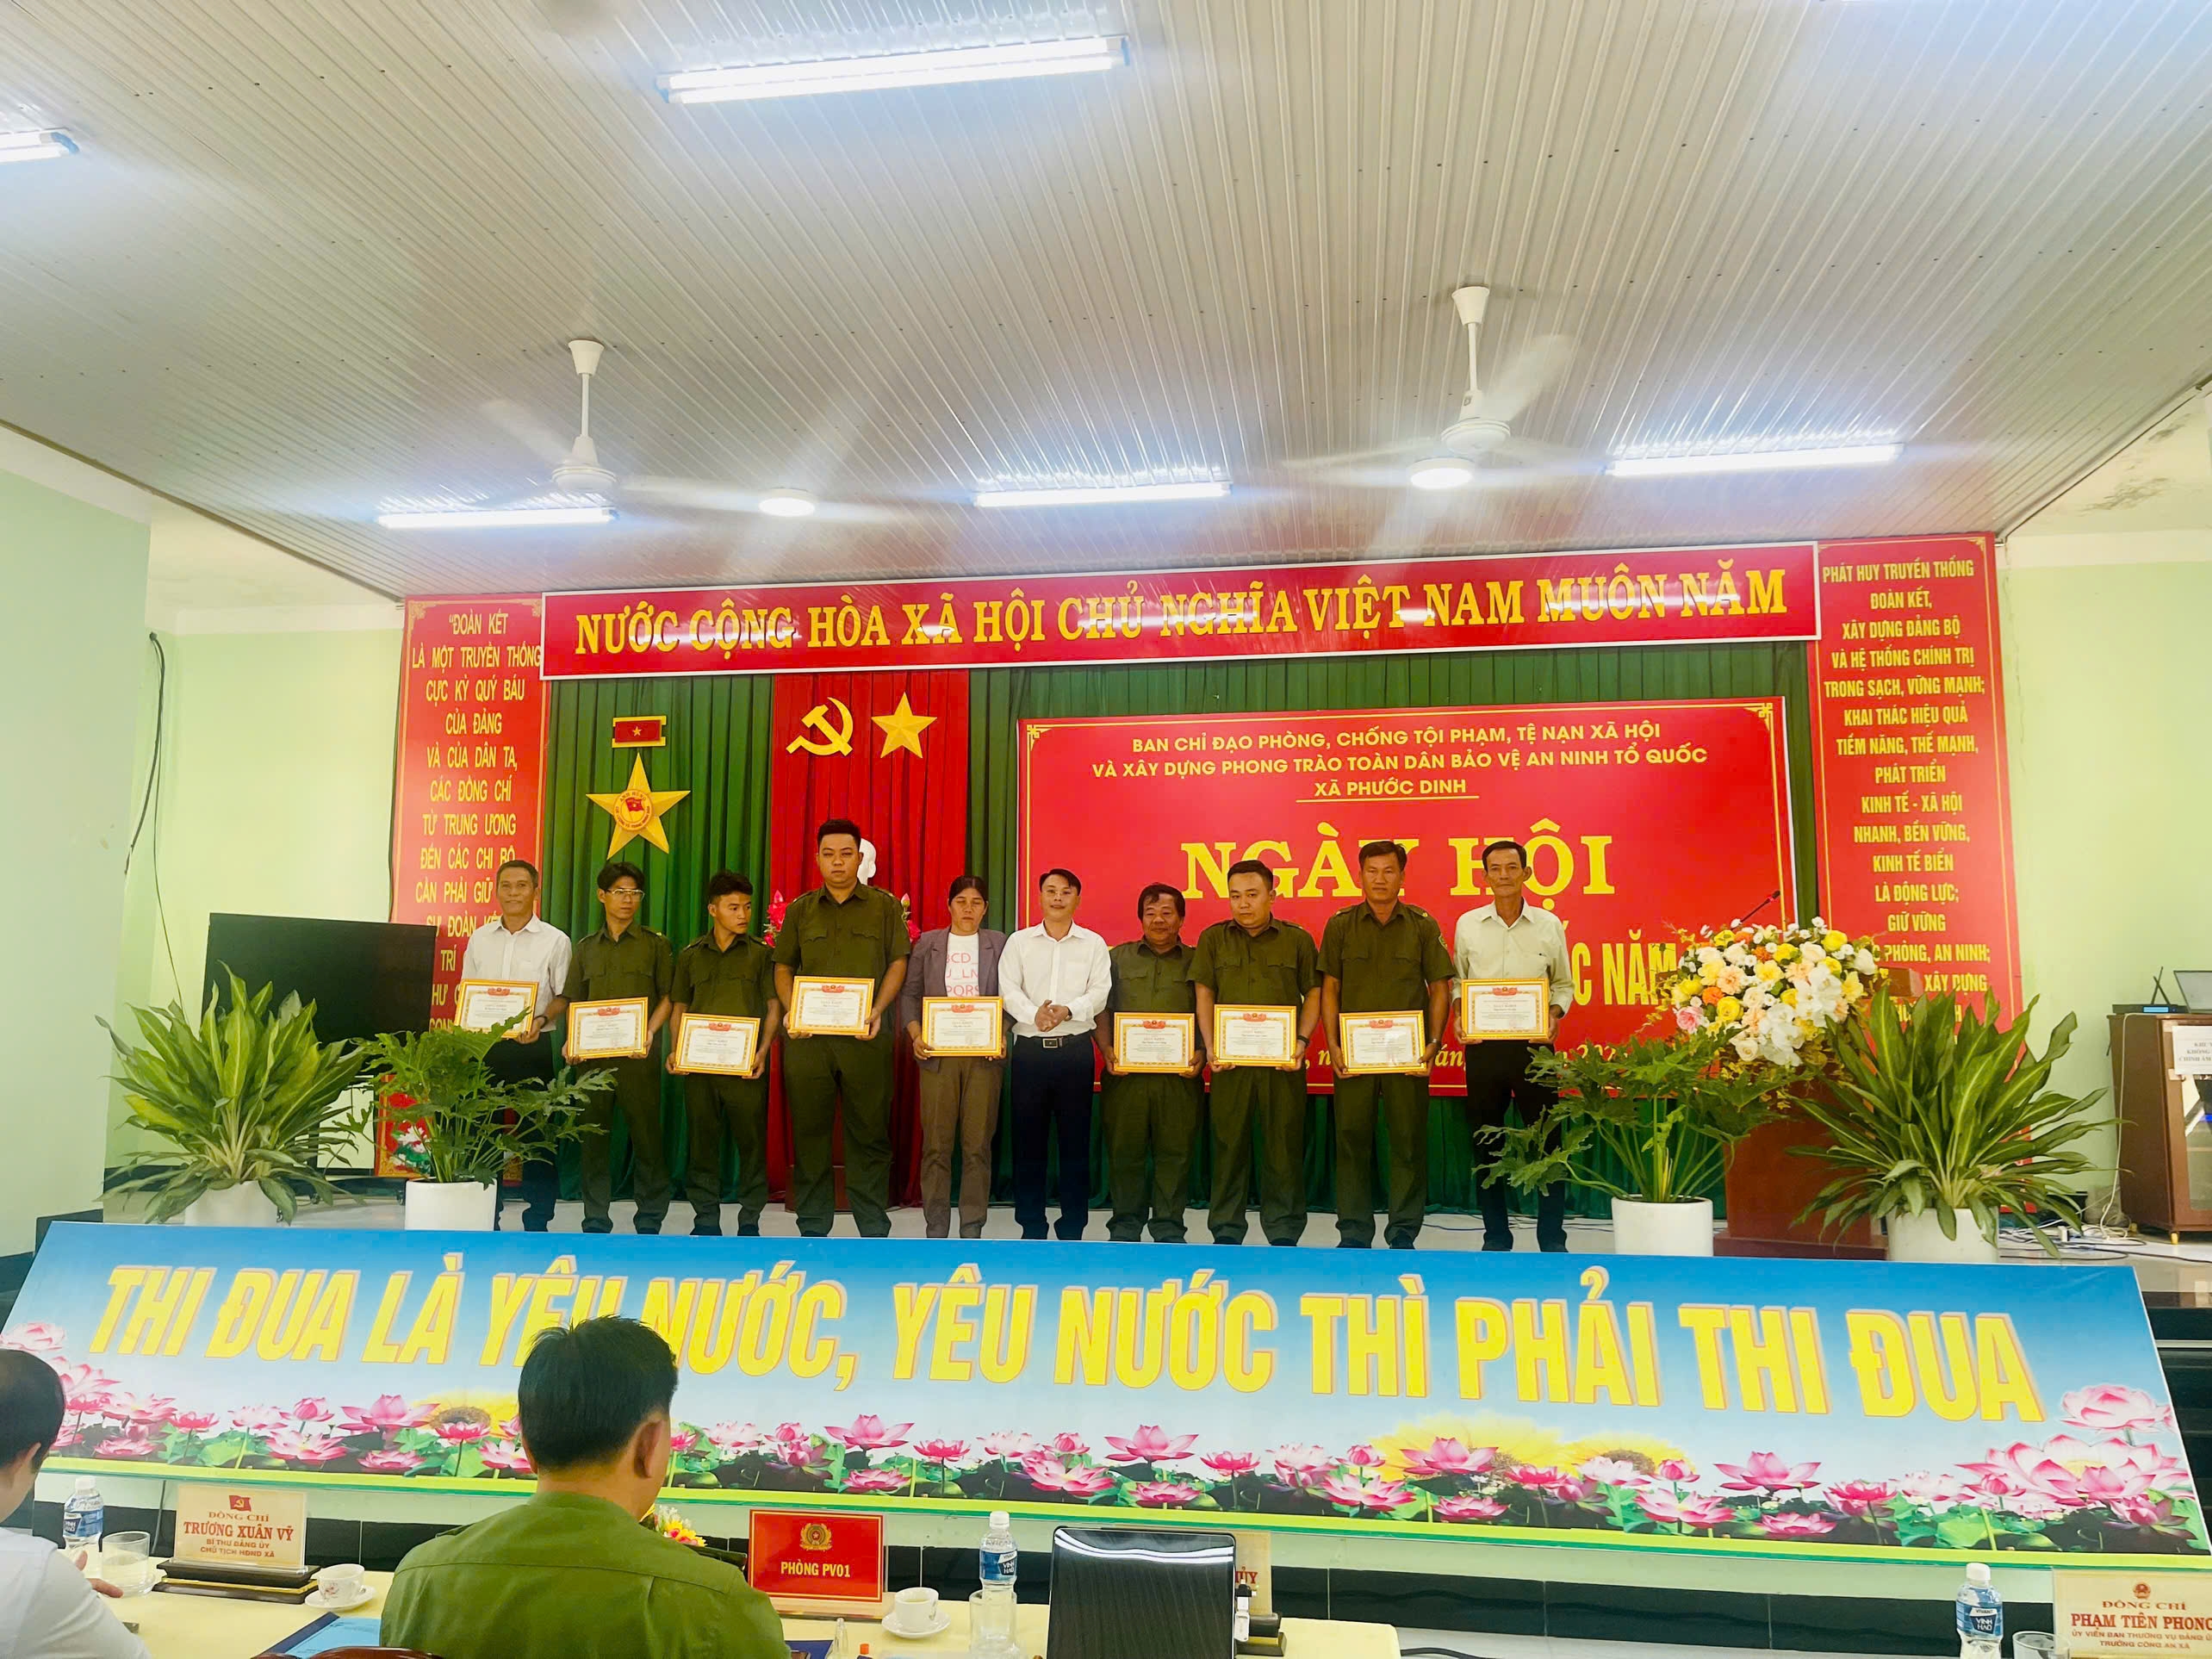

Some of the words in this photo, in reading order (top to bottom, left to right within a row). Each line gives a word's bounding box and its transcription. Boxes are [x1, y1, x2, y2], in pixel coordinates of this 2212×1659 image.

[1823, 562, 1854, 583] PHÁT
[1856, 564, 1880, 581] HUY
[1933, 556, 1974, 578] THỐNG
[575, 600, 680, 655] NƯỚC
[690, 598, 797, 660] CỘNG
[807, 594, 891, 648] HÒA
[902, 592, 963, 646] XÃ
[973, 587, 1046, 652] HỘI
[1058, 580, 1144, 641] CHỦ
[1160, 581, 1297, 637] NGHĨA
[1304, 574, 1411, 640] VIỆT
[1423, 581, 1525, 627] NAM
[1537, 562, 1668, 623] MUÔN
[1679, 558, 1787, 617] NĂM
[1870, 588, 1904, 610] ĐOÀN
[1907, 586, 1932, 609] KẾT,
[488, 608, 508, 635] KẾT
[1842, 619, 1866, 640] XÂY
[1869, 619, 1904, 642] DỰNG
[1906, 613, 1940, 637] ĐẢNG
[1943, 614, 1960, 639] BỘ
[412, 642, 425, 668] LÀ
[432, 644, 454, 674] MỘT
[461, 641, 500, 668] TRUYỀN
[506, 641, 542, 668] THỐNG
[1831, 648, 1848, 669] VÀ
[1850, 647, 1867, 672] HỆ
[1869, 643, 1910, 668] THỐNG
[1913, 644, 1952, 666] CHÍNH
[1954, 647, 1975, 668] TRỊ
[426, 680, 449, 707] CỰC
[475, 674, 497, 702] QUÝ
[503, 674, 525, 701] BÁU
[1824, 680, 1864, 698] TRONG
[1867, 679, 1904, 699] SẠCH,
[1907, 674, 1941, 695] VỮNG
[1943, 675, 1985, 697] MẠNH;
[445, 707, 467, 735] CỦA
[473, 707, 502, 735] ĐẢNG
[1844, 709, 1873, 726] KHAI
[1876, 705, 1908, 725] THÁC
[1911, 704, 1939, 728] HIỆU
[1942, 700, 1968, 724] QUẢ
[1133, 738, 1169, 753] BAN
[1174, 731, 1207, 751] CHỈ
[1212, 735, 1253, 754] ĐẠO
[1258, 731, 1331, 750] PHÒNG,
[1336, 726, 1408, 747] CHỐNG
[1414, 725, 1444, 747] TỘI
[1450, 727, 1511, 747] PHẠM,
[1517, 721, 1537, 745] TỆ
[1543, 725, 1582, 744] NẠN
[1591, 721, 1619, 740] XÃ
[1625, 719, 1661, 743] HỘI
[1869, 734, 1908, 755] NĂNG,
[1911, 730, 1934, 754] THẾ
[1937, 735, 1979, 756] MẠNH,
[426, 742, 440, 768] VÀ
[447, 742, 469, 768] CỦA
[475, 742, 496, 768] DÂN
[503, 746, 518, 772] TA,
[1092, 760, 1117, 778] VÀ
[1122, 759, 1159, 777] XÂY
[1164, 760, 1216, 780] DỰNG
[1221, 758, 1289, 775] PHONG
[1293, 756, 1342, 773] TRÀO
[1347, 753, 1399, 771] TOÀN
[1404, 750, 1441, 770] DÂN
[1451, 748, 1492, 768] BẢO
[1497, 748, 1520, 771] VỆ
[1525, 751, 1554, 767] AN
[1560, 749, 1609, 766] NINH
[1613, 742, 1640, 764] TỔ
[1645, 743, 1707, 765] QUỐC
[1874, 762, 1907, 784] PHÁT
[1910, 759, 1946, 783] TRIỂN
[430, 775, 451, 802] CÁC
[457, 775, 488, 802] ĐỒNG
[494, 774, 513, 802] CHÍ
[1314, 779, 1340, 797] XÃ
[1346, 775, 1414, 795] PHƯỚC
[1420, 780, 1466, 794] DINH
[1861, 796, 1892, 813] KINH
[1894, 790, 1910, 813] TẾ
[1921, 792, 1938, 812] XÃ
[1942, 791, 1963, 816] HỘI
[422, 809, 438, 836] TỪ
[444, 813, 478, 836] TRUNG
[484, 813, 517, 836] ƯƠNG
[1854, 825, 1901, 844] NHANH,
[1932, 821, 1970, 843] VỮNG,
[420, 842, 442, 869] ĐẾN
[448, 842, 469, 869] CÁC
[476, 847, 494, 869] CHI
[1448, 817, 1615, 911] HỘI
[1873, 854, 1903, 873] KINH
[1906, 848, 1921, 872] TẾ
[1924, 847, 1954, 872] BIỂN
[415, 876, 438, 904] CẦN
[444, 876, 468, 904] PHẢI
[474, 877, 494, 904] GIỮ
[1874, 881, 1891, 903] LÀ
[1893, 881, 1929, 905] ĐỘNG
[1931, 883, 1959, 904] LỰC;
[448, 910, 476, 938] ĐOÀN
[1887, 911, 1910, 931] GIỮ
[1912, 910, 1946, 931] VỮNG
[441, 945, 457, 972] TRÍ
[1884, 940, 1931, 963] PHÒNG,
[1934, 944, 1952, 961] AN
[1955, 944, 1991, 963] NINH;
[1602, 929, 1677, 1005] NĂM
[432, 984, 449, 1006] HƯ
[1923, 971, 1948, 992] XÂY
[1953, 972, 1988, 996] DỰNG
[89, 1264, 216, 1358] THI
[205, 1268, 362, 1362] ĐUA
[361, 1252, 466, 1365] LÀ
[640, 1260, 857, 1392] NƯỚC,
[892, 1264, 1038, 1383] YÊU
[1053, 1269, 1278, 1394] NƯỚC
[1299, 1273, 1431, 1399] THÌ
[1454, 1264, 1662, 1407] PHẢI
[1678, 1303, 1830, 1414] THI
[1845, 1308, 2047, 1422] ĐUA
[183, 1521, 233, 1538] TRƯƠNG
[237, 1524, 272, 1541] XUÂN
[780, 1558, 819, 1576] PHÒNG
[822, 1563, 851, 1578] PV01
[2071, 1613, 2116, 1631] PHẠM
[2163, 1616, 2212, 1631] PHONG
